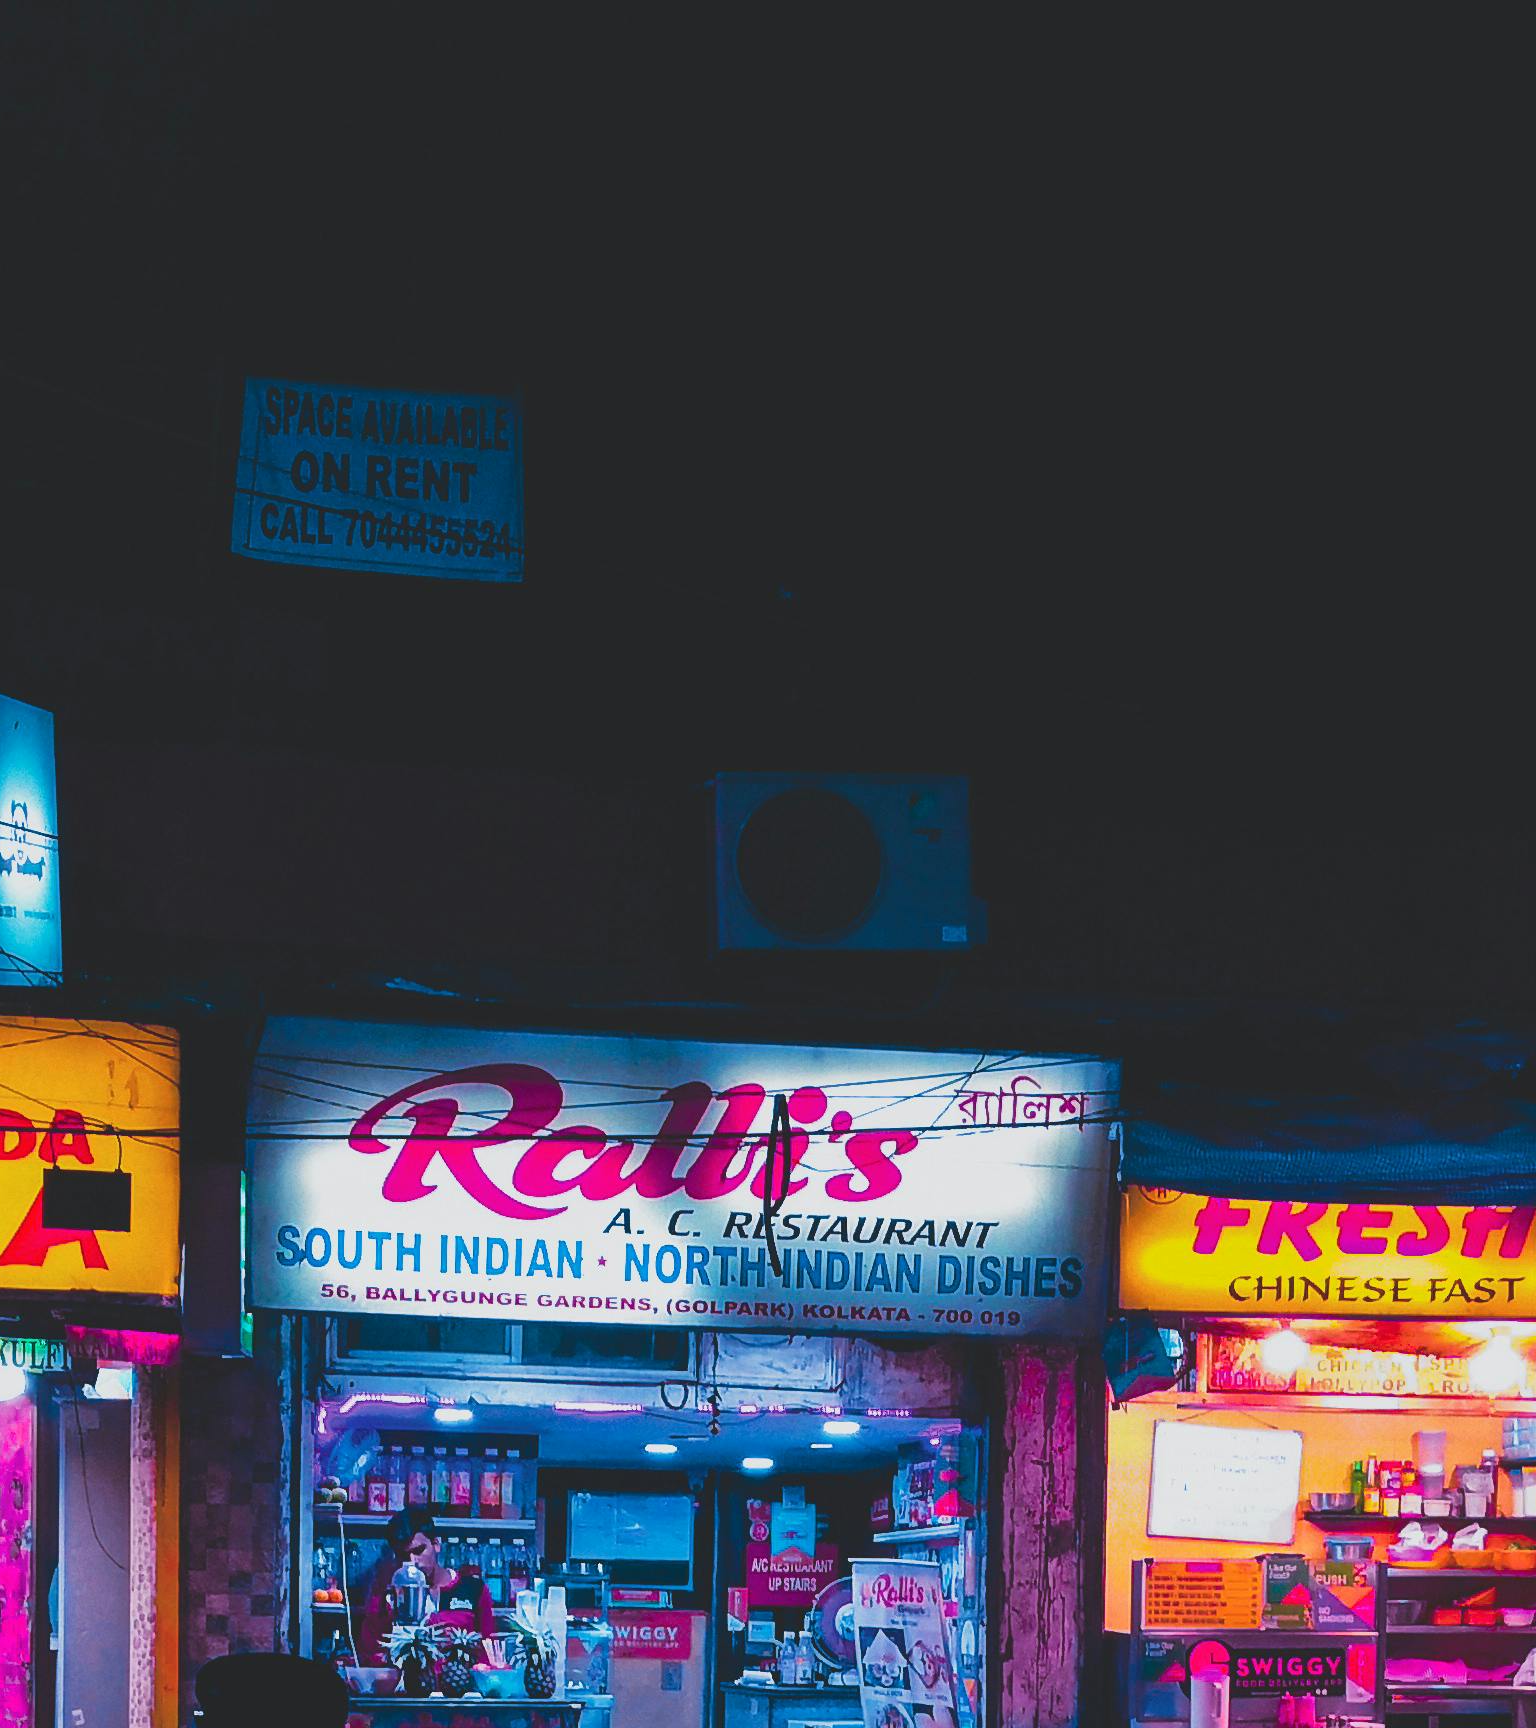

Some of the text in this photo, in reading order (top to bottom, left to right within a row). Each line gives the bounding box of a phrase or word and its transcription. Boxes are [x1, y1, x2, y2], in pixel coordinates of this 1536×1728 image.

[265, 385, 511, 452] SPACE AVAILABLE
[291, 450, 478, 504] ON RENT
[260, 503, 334, 546] CALL
[348, 1061, 920, 1221] Ralli's
[603, 1208, 1000, 1249] A. C. RESTAURANT
[276, 1224, 1084, 1299] SOUTH INDIAN NORTH INDIAN DISHES
[321, 1283, 357, 1302] 56,
[365, 1286, 528, 1307] BALLYGUNGE
[537, 1294, 659, 1315] GARDENS,
[666, 1299, 795, 1320] (GOLPARK)
[802, 1304, 911, 1322] KOLKATA
[933, 1308, 972, 1324] 700
[980, 1310, 1021, 1327] 019
[1227, 1274, 1413, 1304] CHINESE
[1429, 1274, 1527, 1305] FAST
[752, 1558, 769, 1573] A/C
[768, 1577, 817, 1592] UP STAIRS
[614, 1626, 678, 1641] WIGGY
[1236, 1656, 1341, 1677] SWIGGY
